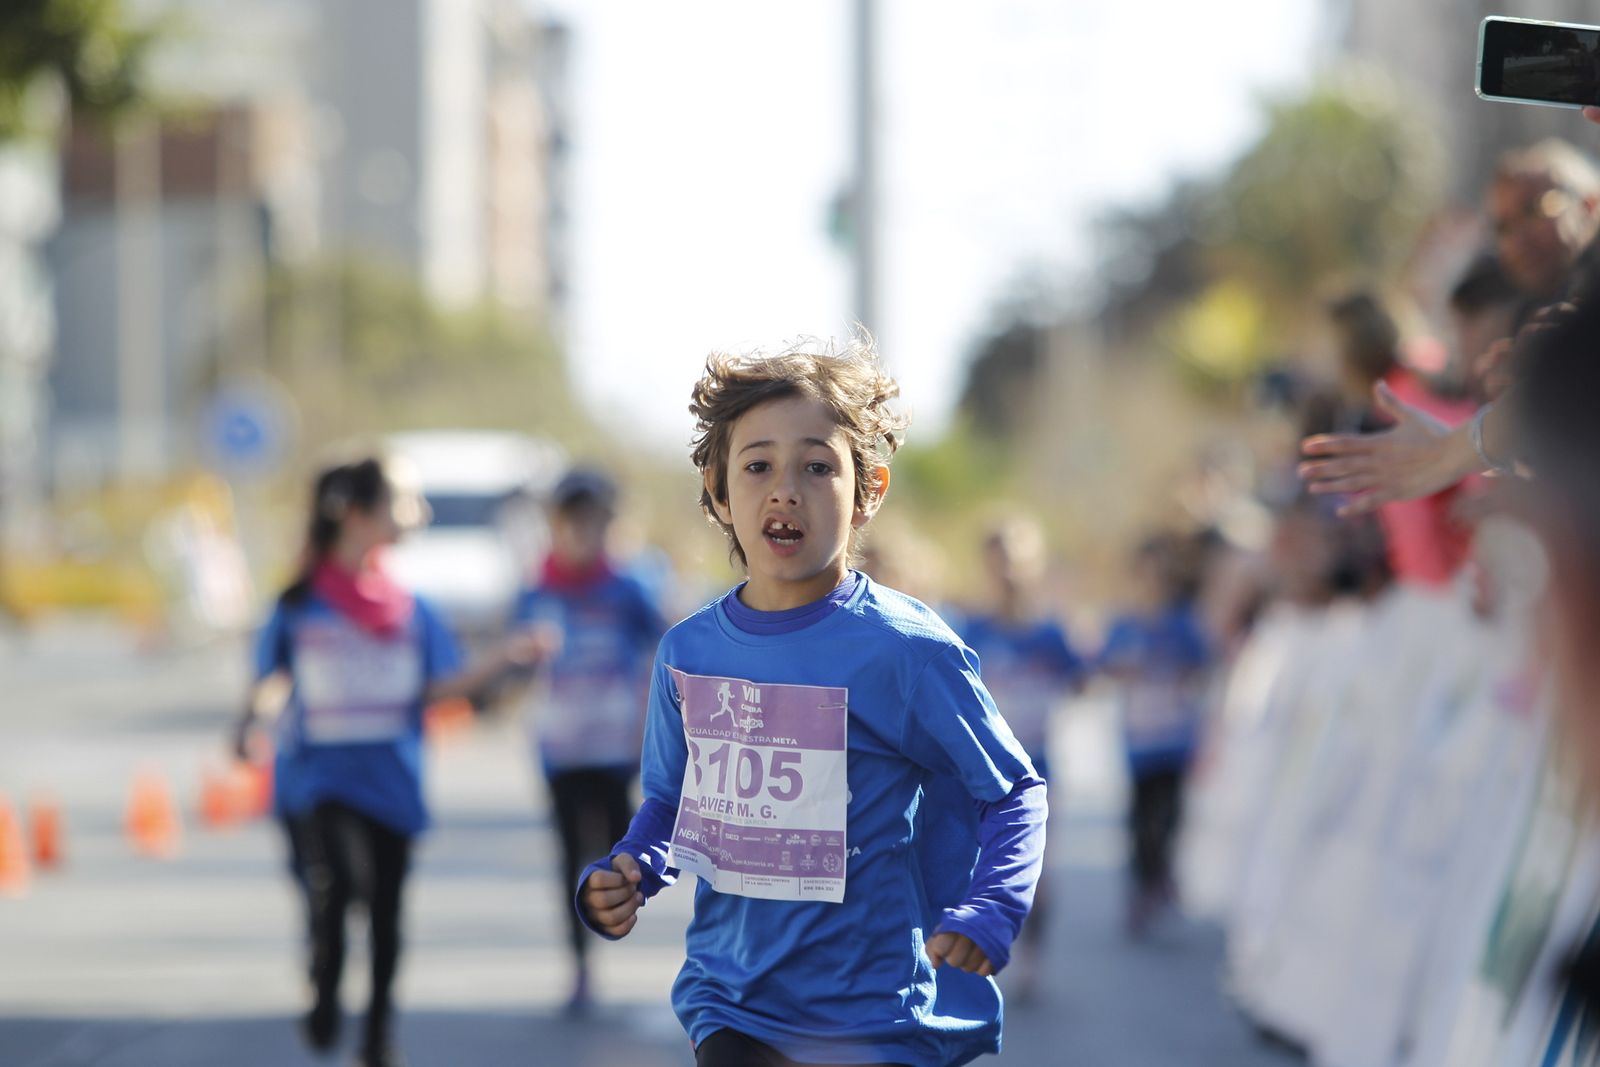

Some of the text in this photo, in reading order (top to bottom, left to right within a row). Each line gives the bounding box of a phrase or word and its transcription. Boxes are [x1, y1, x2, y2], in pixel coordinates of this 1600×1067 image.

[742, 685, 761, 703] VII
[689, 727, 731, 738] GUALDAD
[772, 736, 798, 746] META
[698, 796, 734, 815] AVIER
[737, 802, 755, 818] M.
[759, 804, 778, 820] G.
